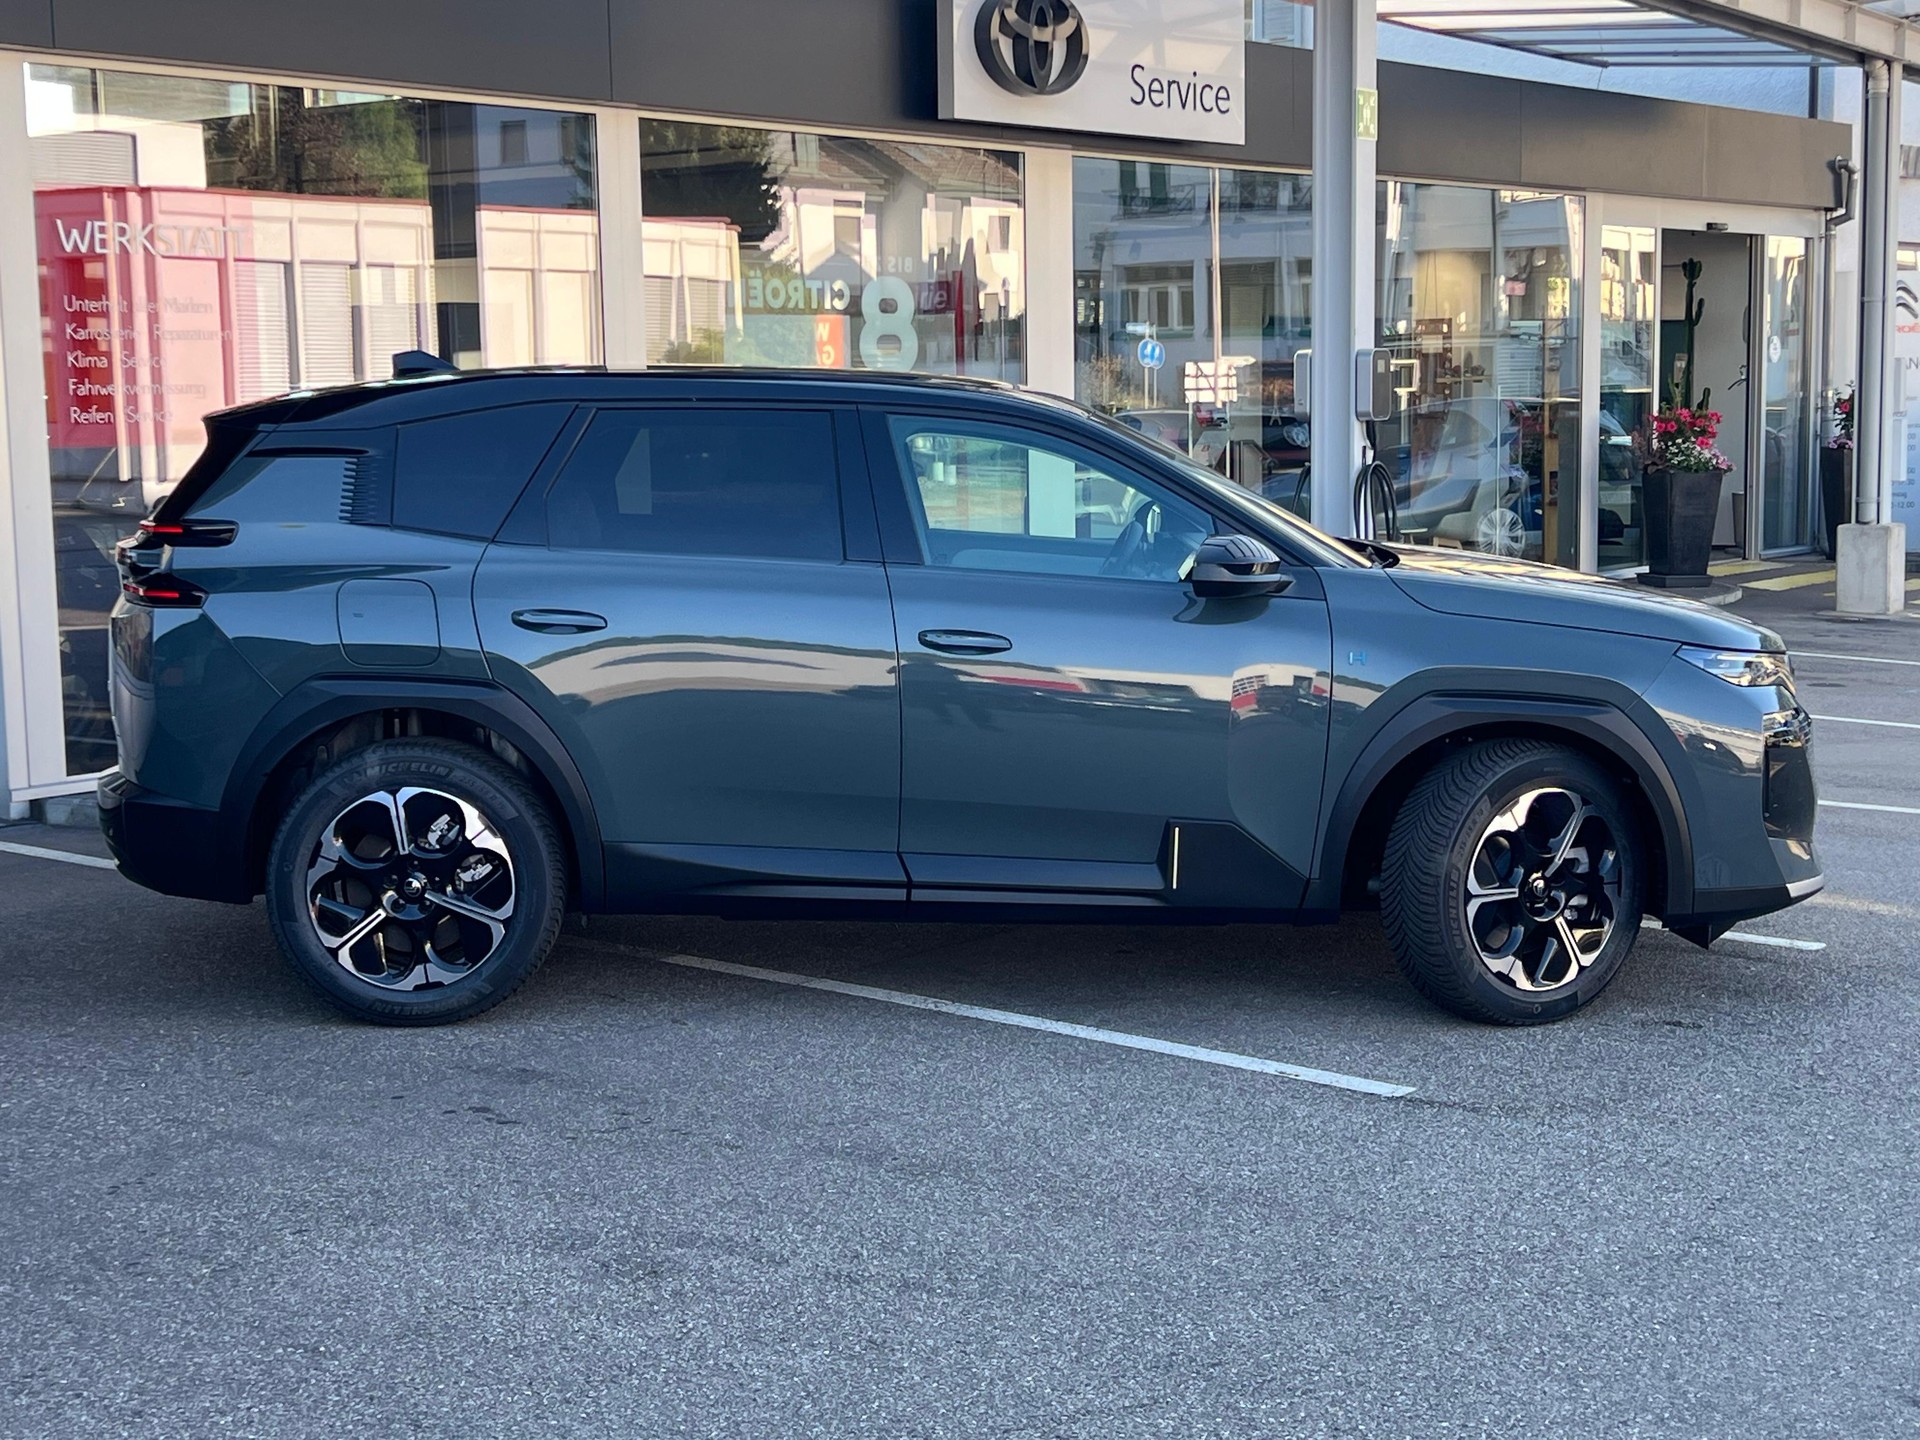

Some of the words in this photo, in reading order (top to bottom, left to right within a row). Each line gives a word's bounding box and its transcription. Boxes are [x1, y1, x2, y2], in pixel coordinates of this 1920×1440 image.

[1130, 63, 1231, 115] Service
[55, 217, 250, 257] WERKSTATT
[63, 294, 129, 314] Unterhlt
[66, 350, 109, 369] Klima
[121, 351, 168, 370] Seice
[68, 378, 207, 401] Fahrwekvermessung
[70, 406, 114, 425] Reifen
[365, 761, 450, 778] MICHELIN
[1448, 868, 1464, 948] MICHELIN
